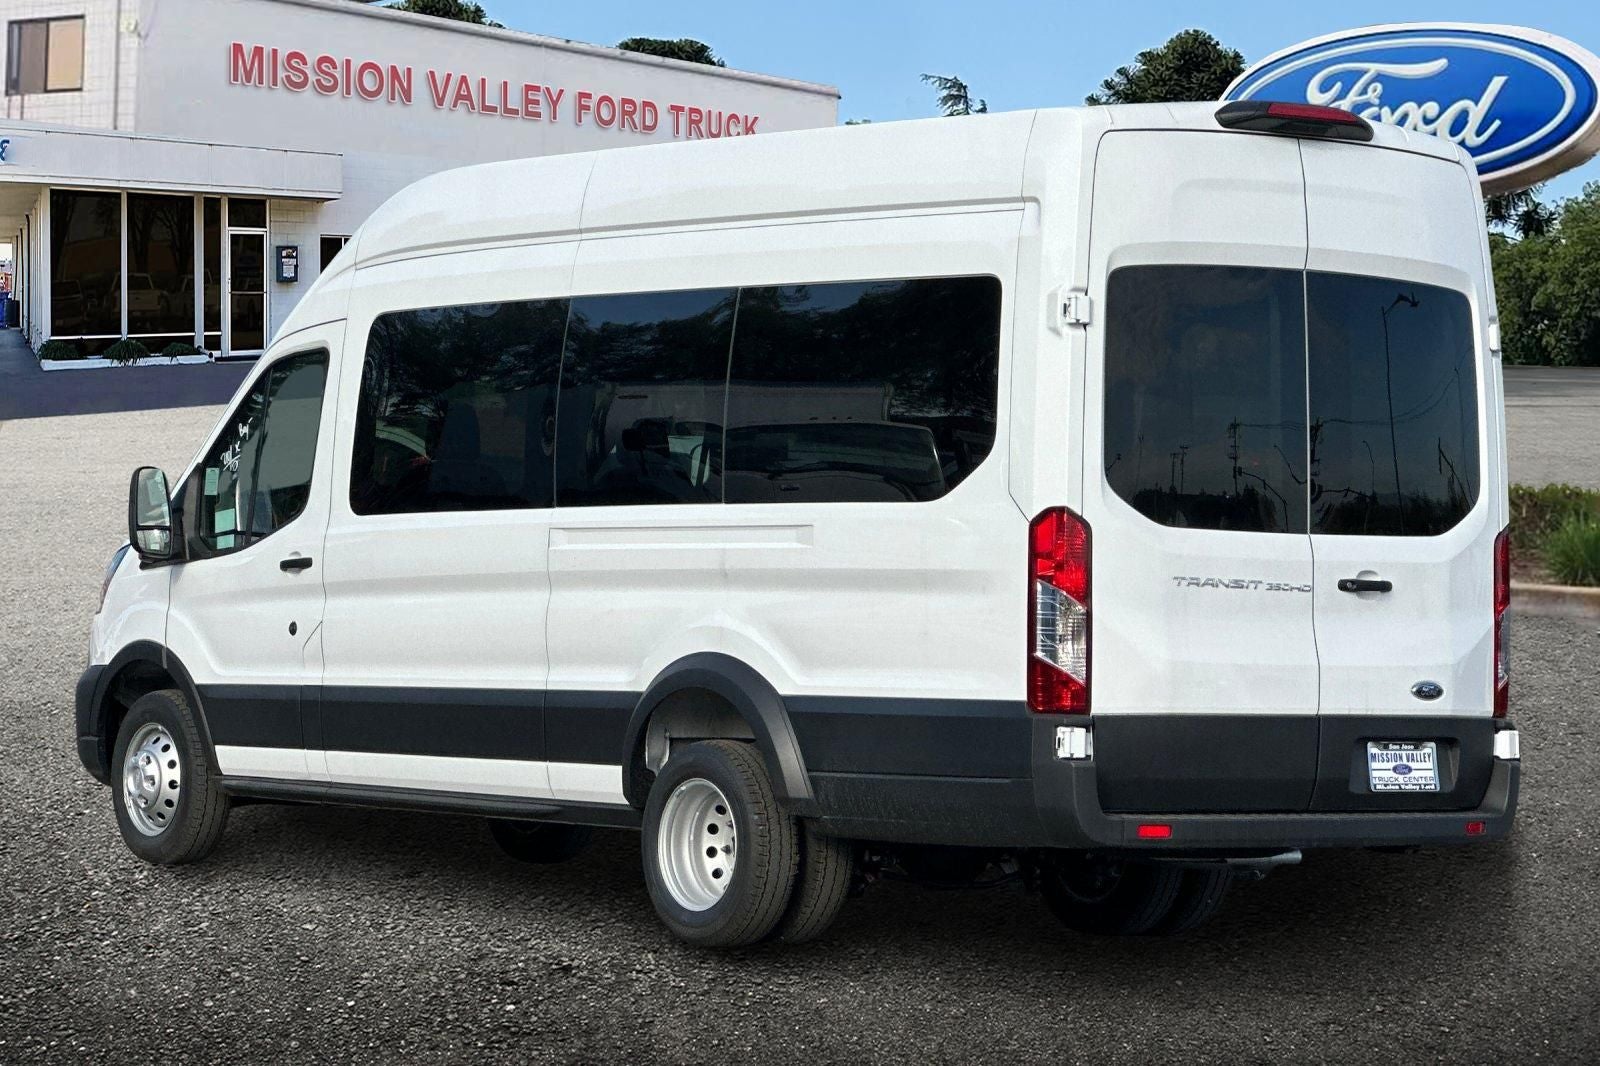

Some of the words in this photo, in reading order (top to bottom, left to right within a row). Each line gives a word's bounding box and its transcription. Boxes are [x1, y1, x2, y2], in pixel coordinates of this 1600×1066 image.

[229, 41, 413, 104] MISSION
[427, 69, 565, 121] VALLEY
[576, 90, 659, 133] FORD
[668, 104, 760, 139] TRUCK
[1172, 575, 1263, 590] TRANSIT
[1265, 582, 1312, 593] 350HD
[1370, 752, 1404, 763] MISSION
[1405, 752, 1432, 763] VALLEY
